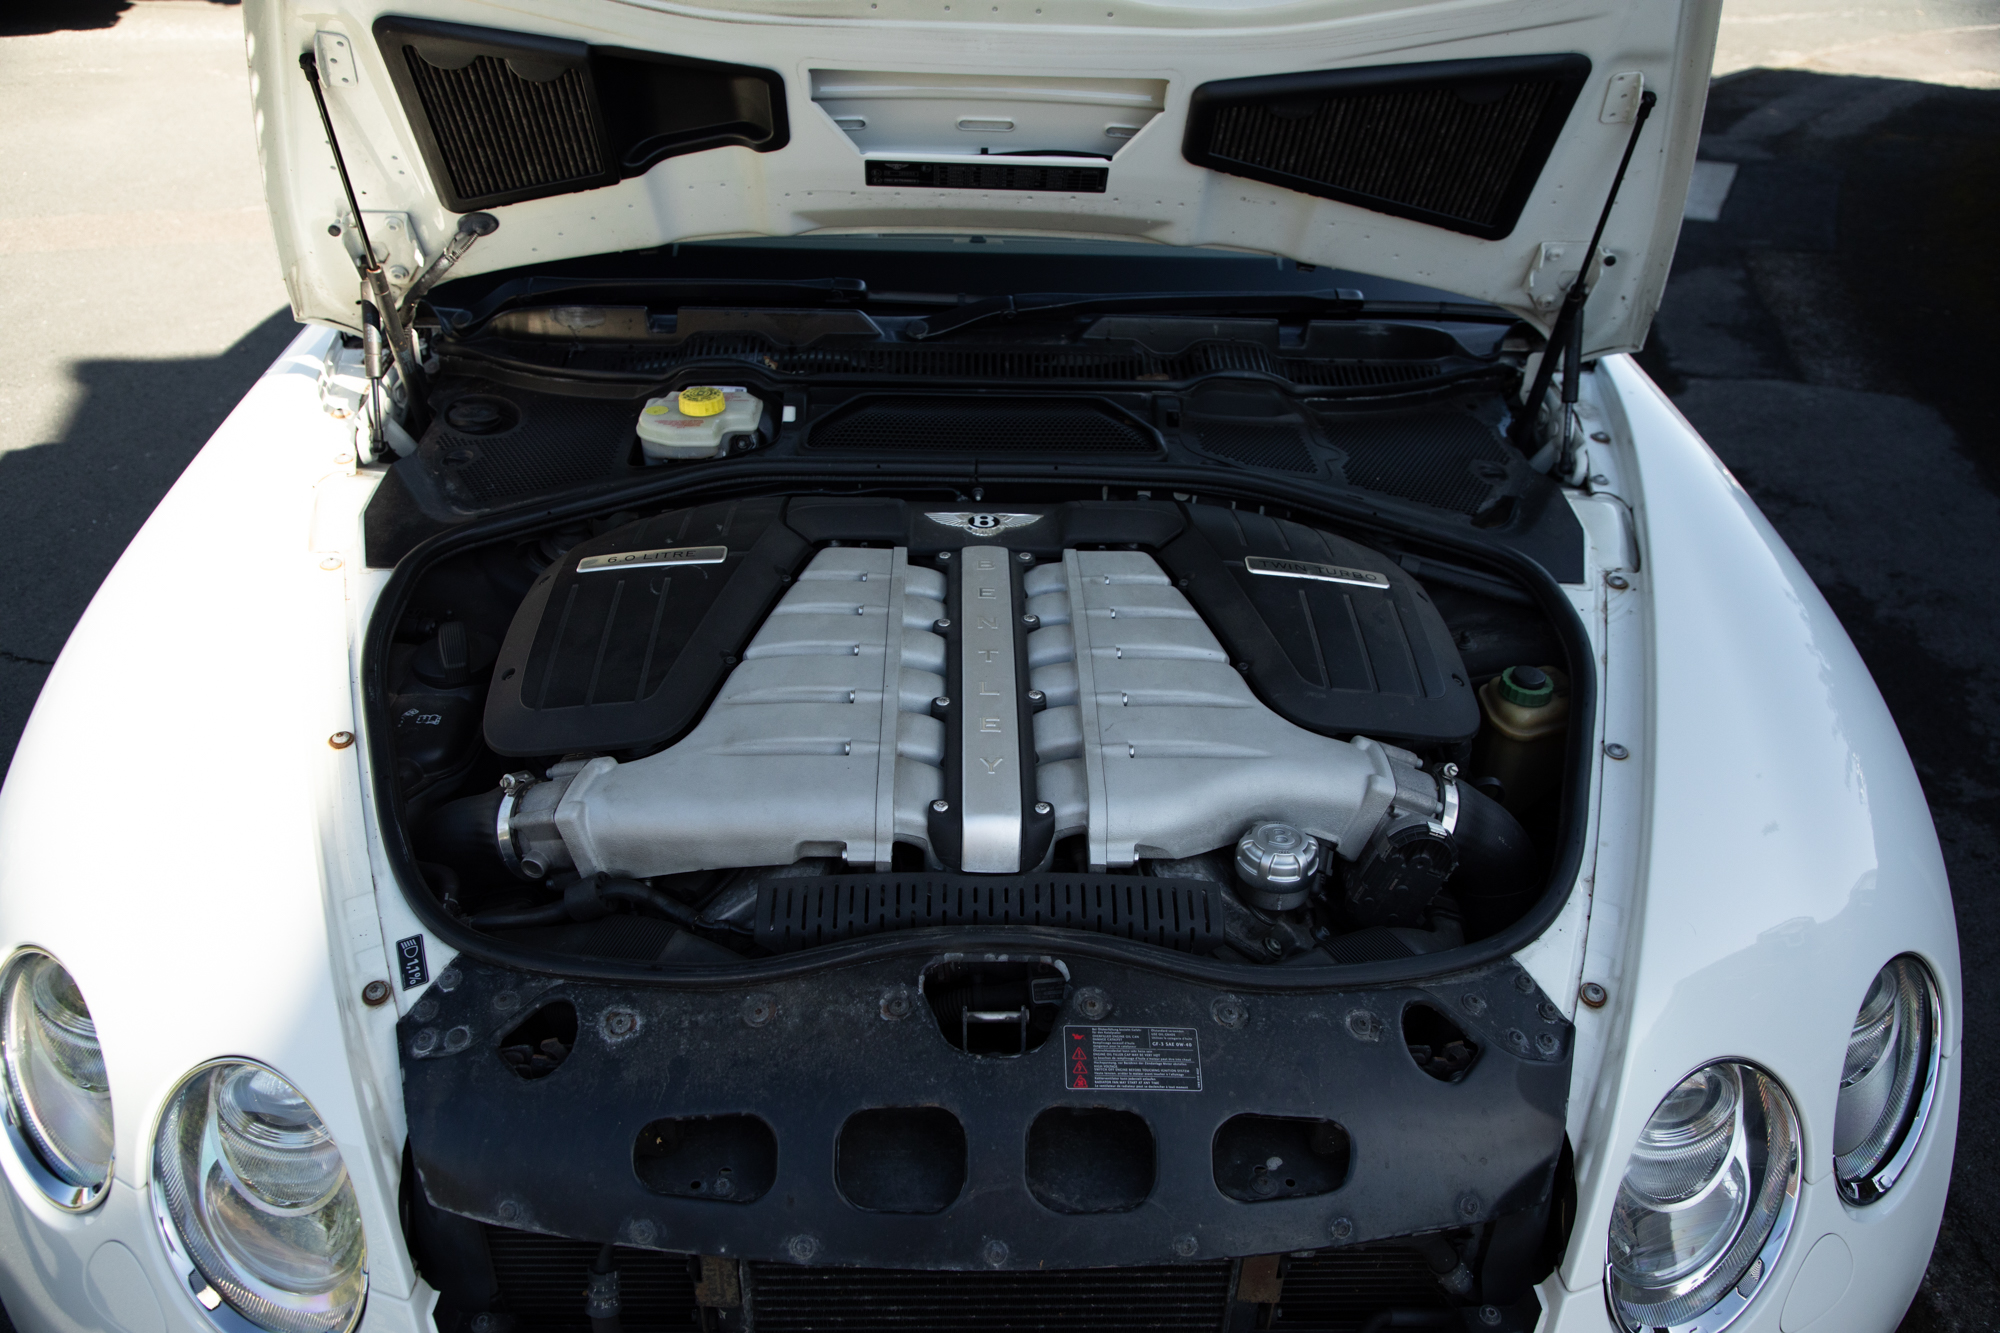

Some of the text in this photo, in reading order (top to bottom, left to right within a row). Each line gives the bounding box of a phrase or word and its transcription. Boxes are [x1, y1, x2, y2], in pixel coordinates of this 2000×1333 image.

[973, 515, 995, 528] B
[607, 550, 697, 563] 6.0 LITRE
[1259, 560, 1377, 581] TWIN TURBO
[976, 560, 1003, 774] BENTLEY
